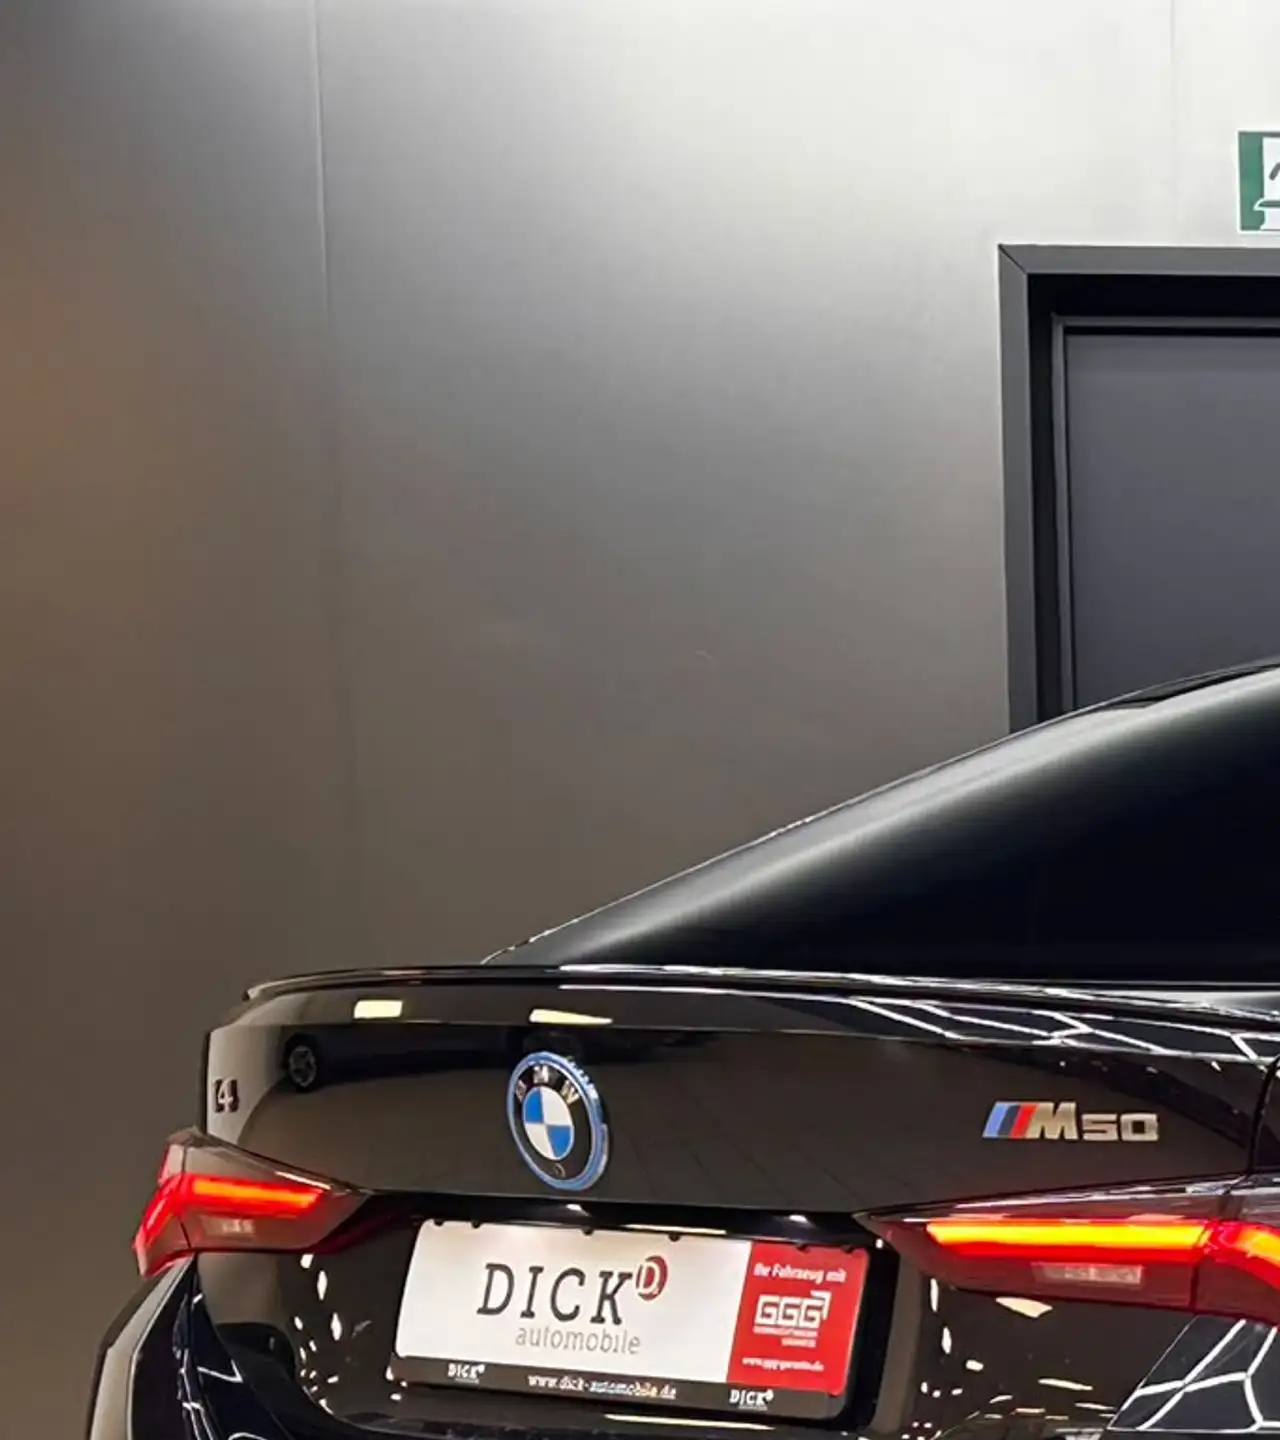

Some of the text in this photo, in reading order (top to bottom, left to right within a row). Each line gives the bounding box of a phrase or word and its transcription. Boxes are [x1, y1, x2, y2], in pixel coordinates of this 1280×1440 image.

[515, 1063, 580, 1105] BMW
[1024, 1100, 1160, 1142] M50
[476, 1261, 634, 1325] DICK
[755, 1295, 826, 1327] GGG
[514, 1324, 641, 1356] automobile
